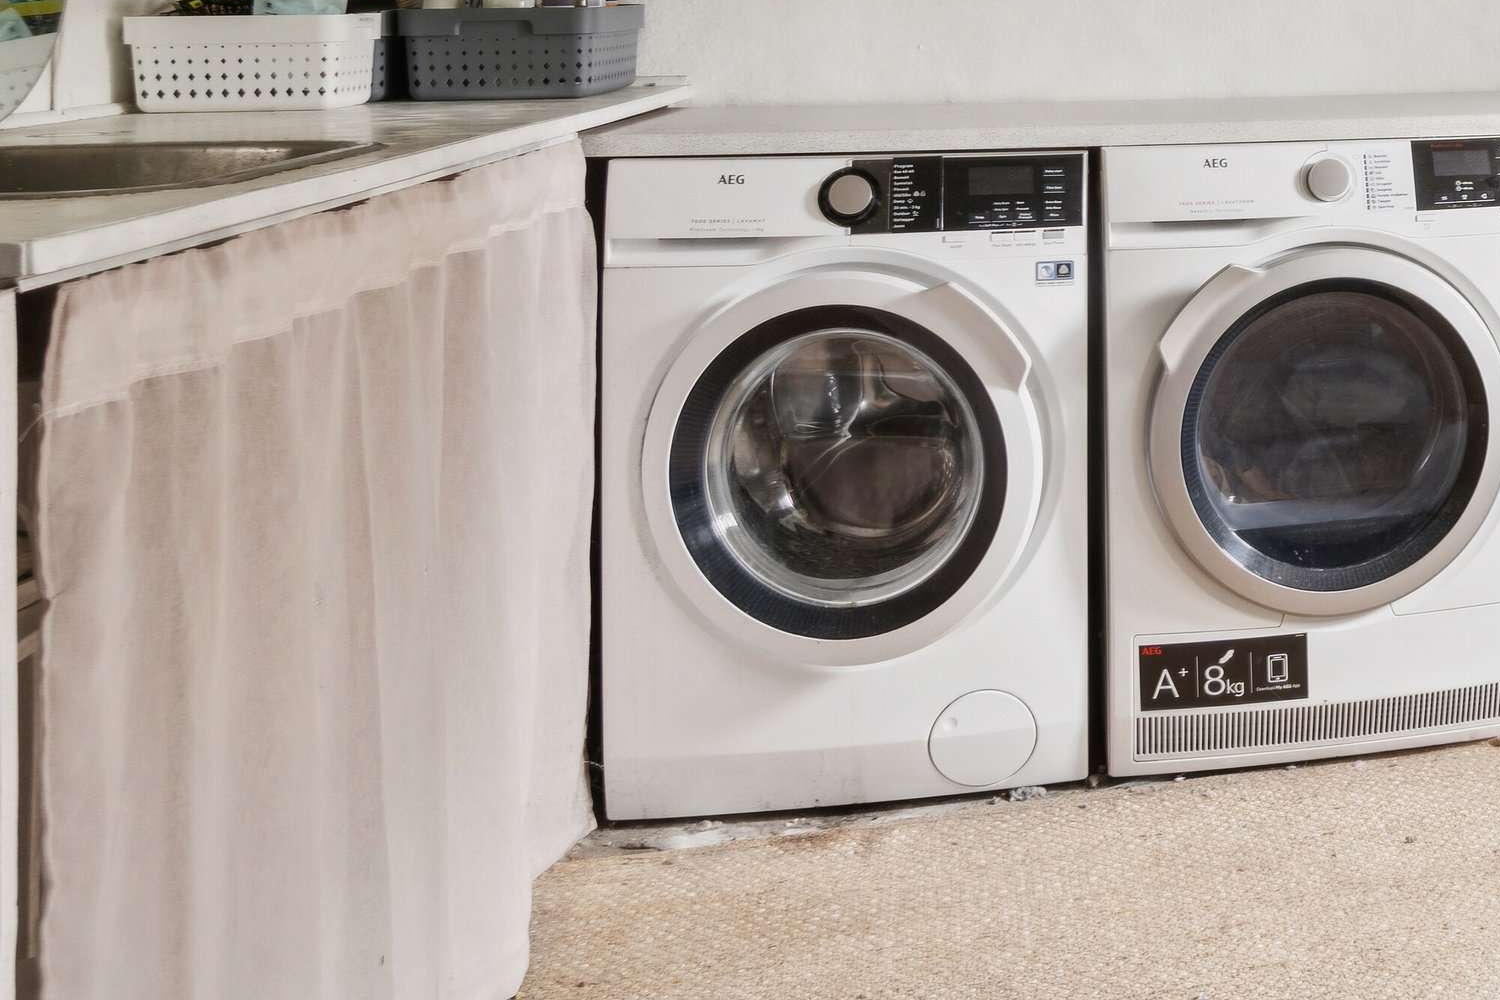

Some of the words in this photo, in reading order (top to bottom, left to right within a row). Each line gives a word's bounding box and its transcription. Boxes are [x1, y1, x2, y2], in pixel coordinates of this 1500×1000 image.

[1203, 158, 1228, 168] AEG
[717, 174, 745, 185] AEG
[1142, 647, 1162, 656] AEG
[1152, 667, 1189, 699] A+
[1203, 665, 1245, 697] 8kg
